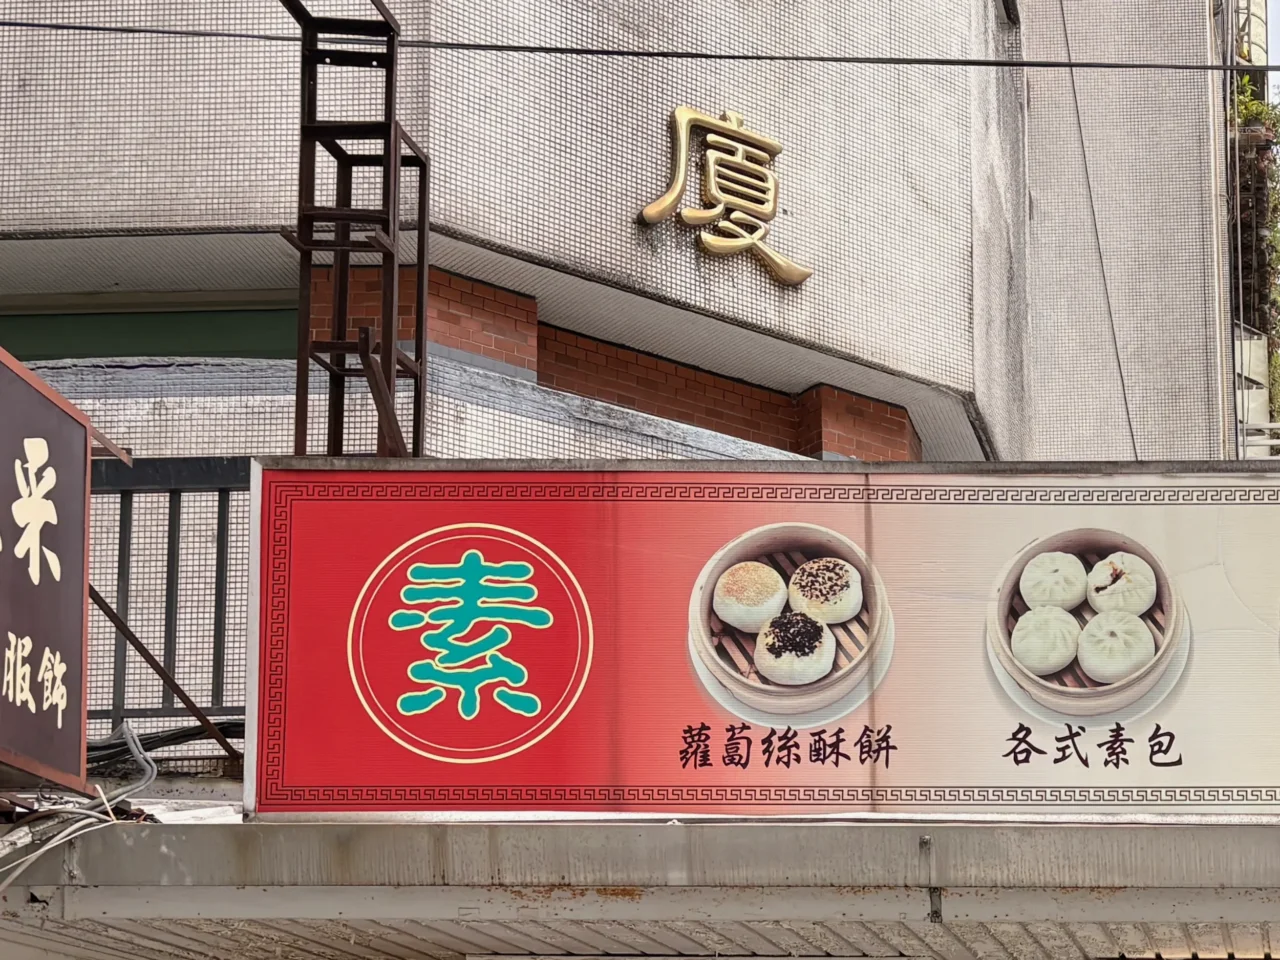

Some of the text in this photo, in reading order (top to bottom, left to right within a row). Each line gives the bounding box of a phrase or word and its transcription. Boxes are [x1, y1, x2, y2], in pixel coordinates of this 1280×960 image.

[643, 105, 813, 285] 廈
[2, 631, 67, 729] 服飾
[388, 549, 553, 720] 素
[679, 722, 898, 770] 蘿蔔絲酥餅
[1002, 723, 1184, 769] 各式素包
